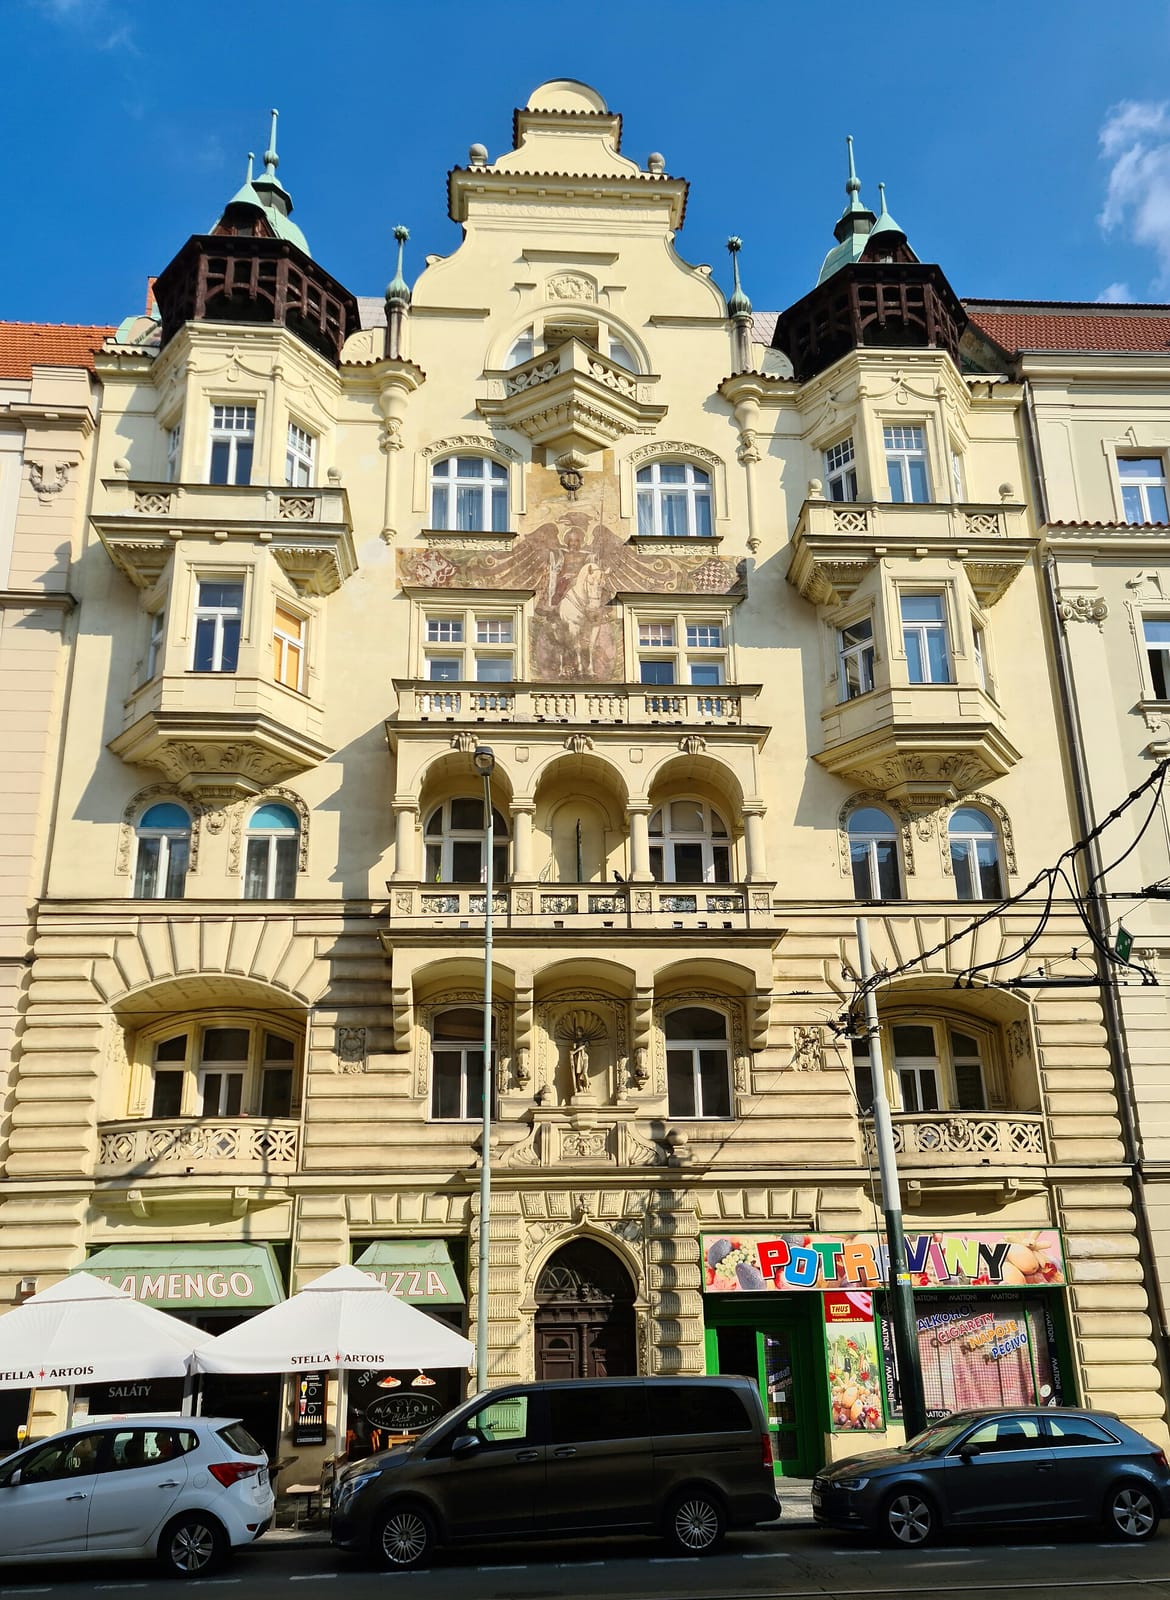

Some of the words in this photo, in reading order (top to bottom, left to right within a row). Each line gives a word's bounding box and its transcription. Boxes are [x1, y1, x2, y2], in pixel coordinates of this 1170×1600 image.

[96, 1272, 254, 1300] AMENGO
[831, 1305, 849, 1313] THUS
[917, 1304, 976, 1330] ALKOHOL
[881, 1319, 890, 1351] MATTONI
[938, 1312, 994, 1342] CIGARETY
[969, 1320, 1018, 1348] NAPOJE
[49, 1365, 94, 1378] ARTOIS
[291, 1354, 331, 1365] STELLA
[343, 1354, 385, 1363] ARTOIS
[108, 1384, 152, 1398] SALÁTY
[885, 1365, 896, 1401] MATTONI
[374, 1404, 435, 1414] MATTONI
